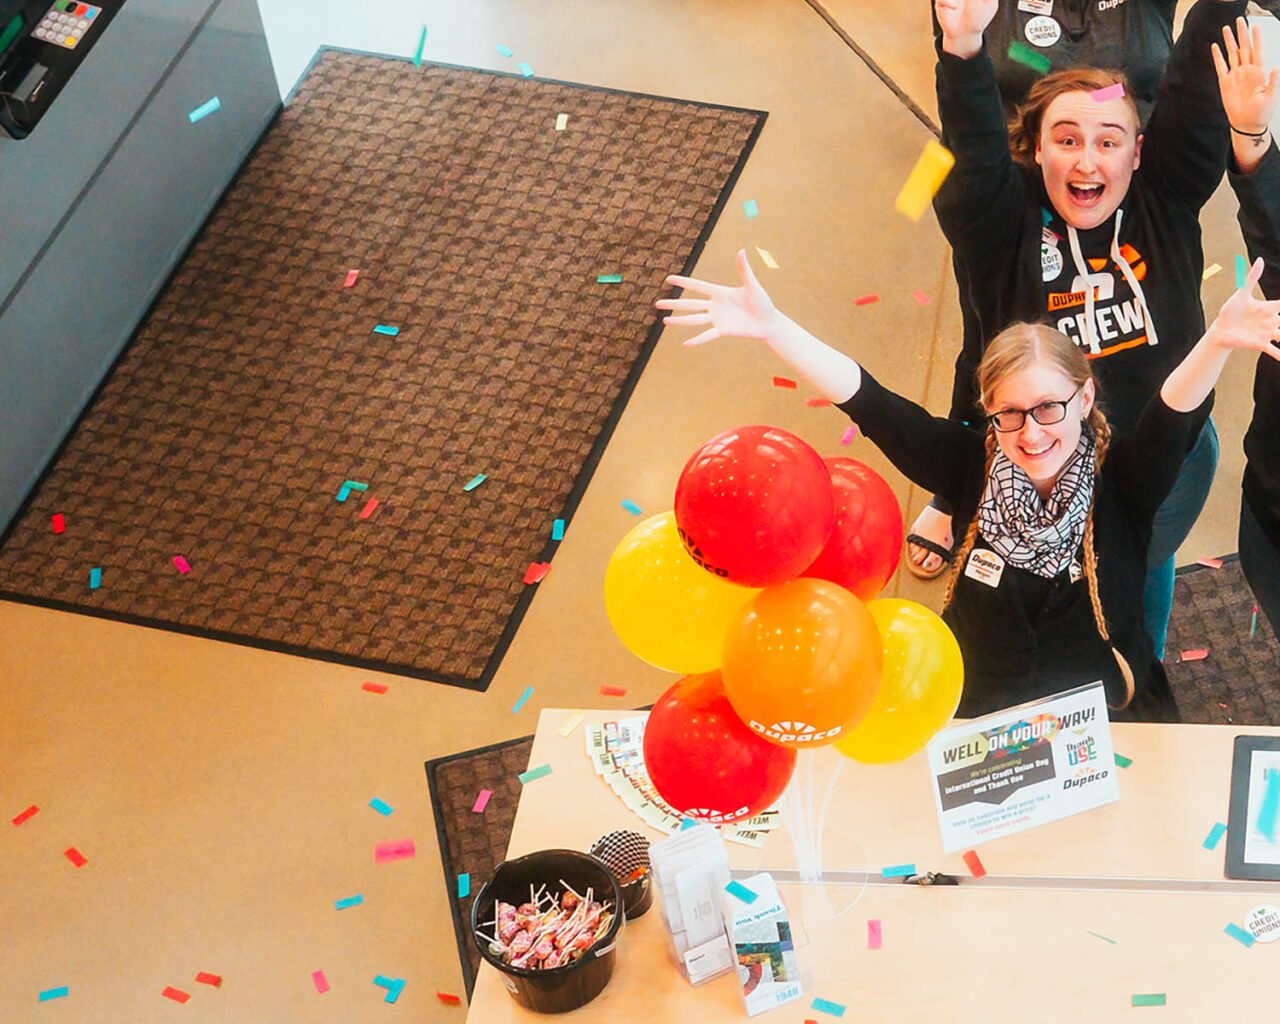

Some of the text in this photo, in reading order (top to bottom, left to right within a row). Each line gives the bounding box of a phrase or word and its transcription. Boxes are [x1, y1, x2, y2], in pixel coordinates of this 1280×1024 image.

[972, 553, 1001, 572] Dupaco
[749, 719, 842, 742] Dupaco
[943, 706, 1096, 765] WELL ON YOUR WAY!
[1066, 735, 1095, 752] Thank
[944, 758, 1050, 795] International Credit Union Day
[973, 774, 1025, 795] and Thank Use
[1062, 770, 1109, 791] Dupaco
[1248, 912, 1278, 930] CREDIT
